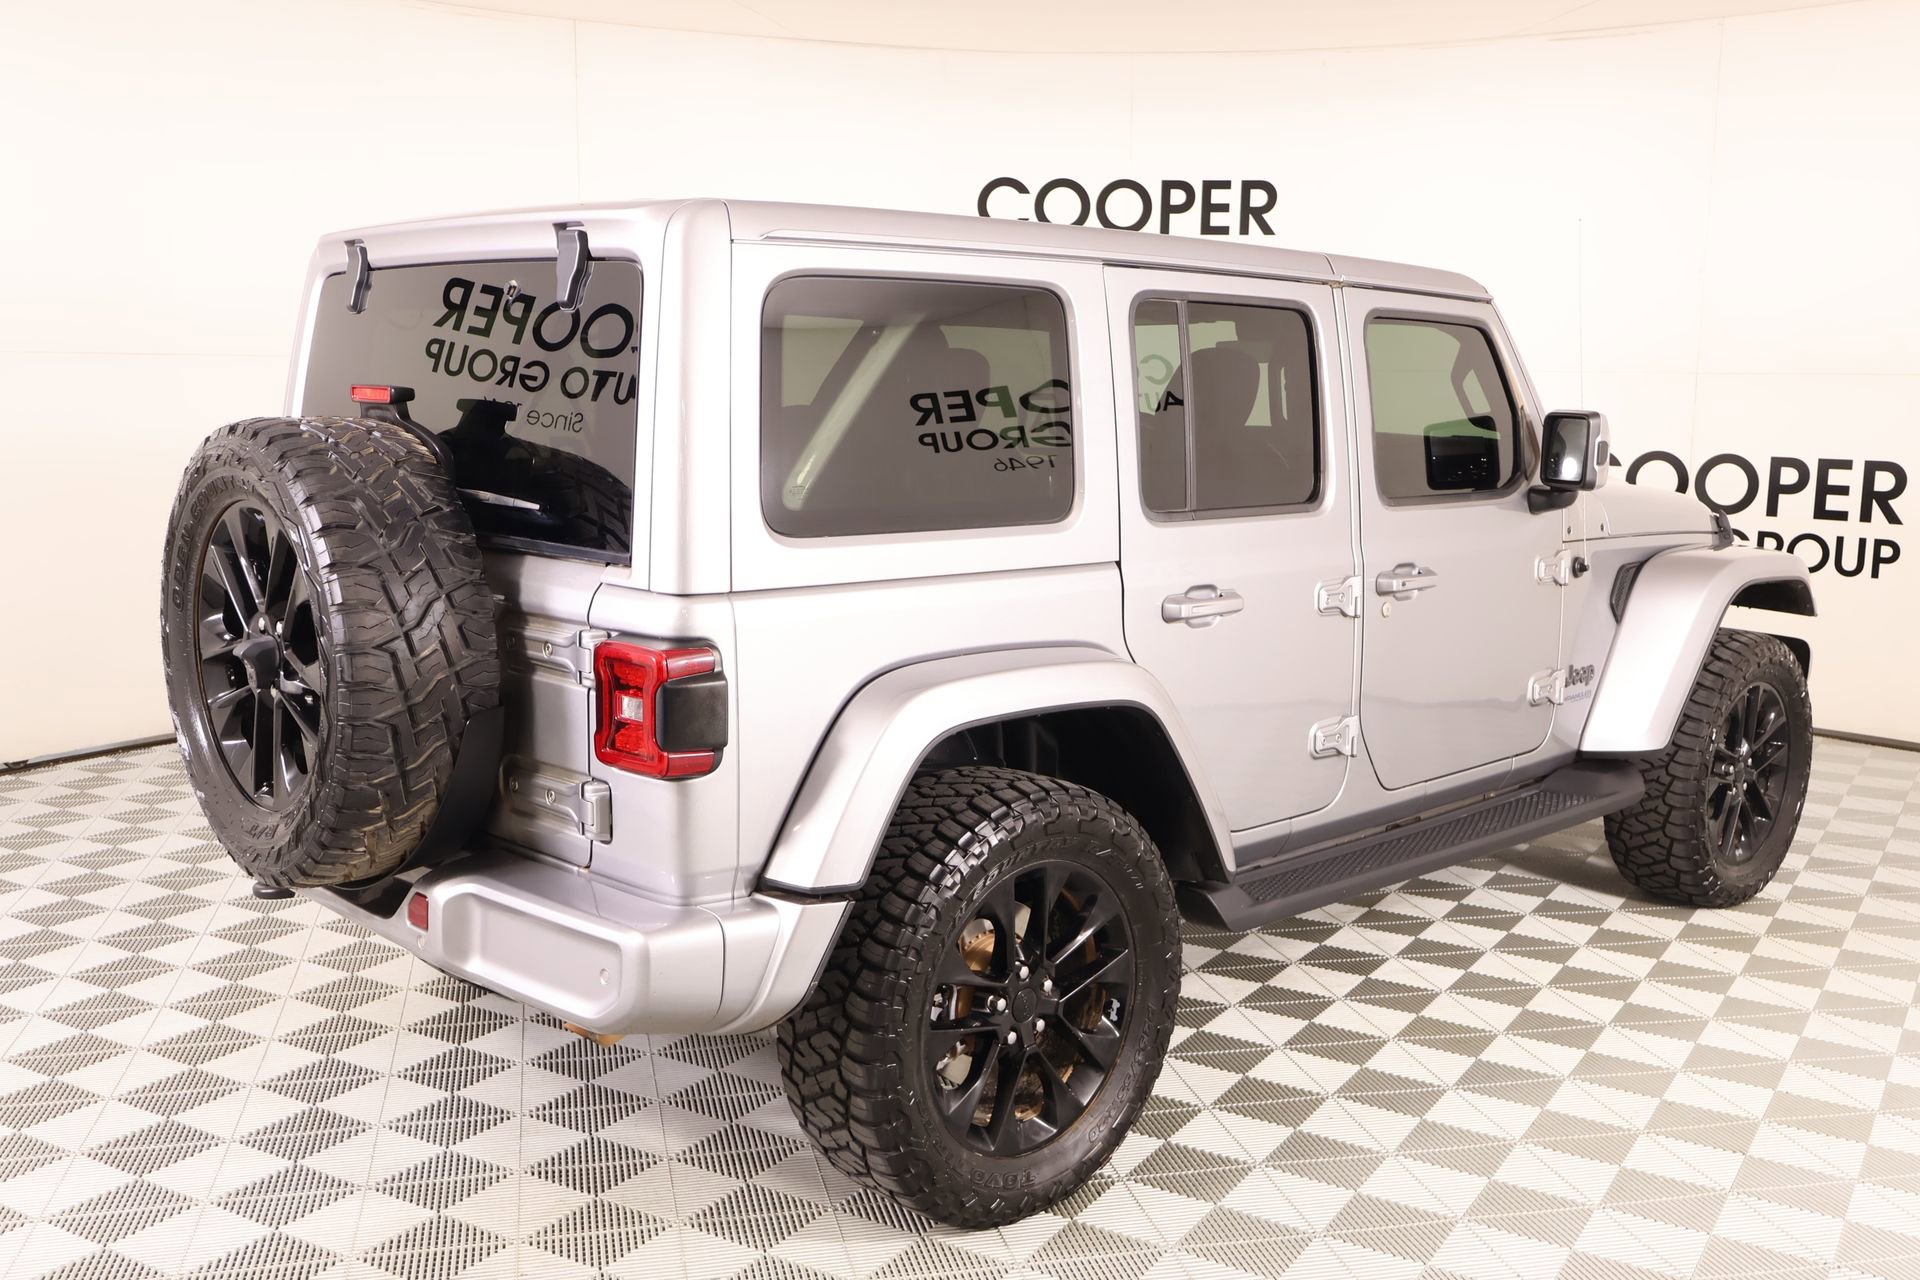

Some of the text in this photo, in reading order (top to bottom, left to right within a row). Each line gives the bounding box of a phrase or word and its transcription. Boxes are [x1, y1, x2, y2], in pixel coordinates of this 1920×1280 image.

[977, 176, 1278, 236] COOPER
[1608, 450, 1908, 526] OOPER
[1564, 664, 1596, 688] Jeep
